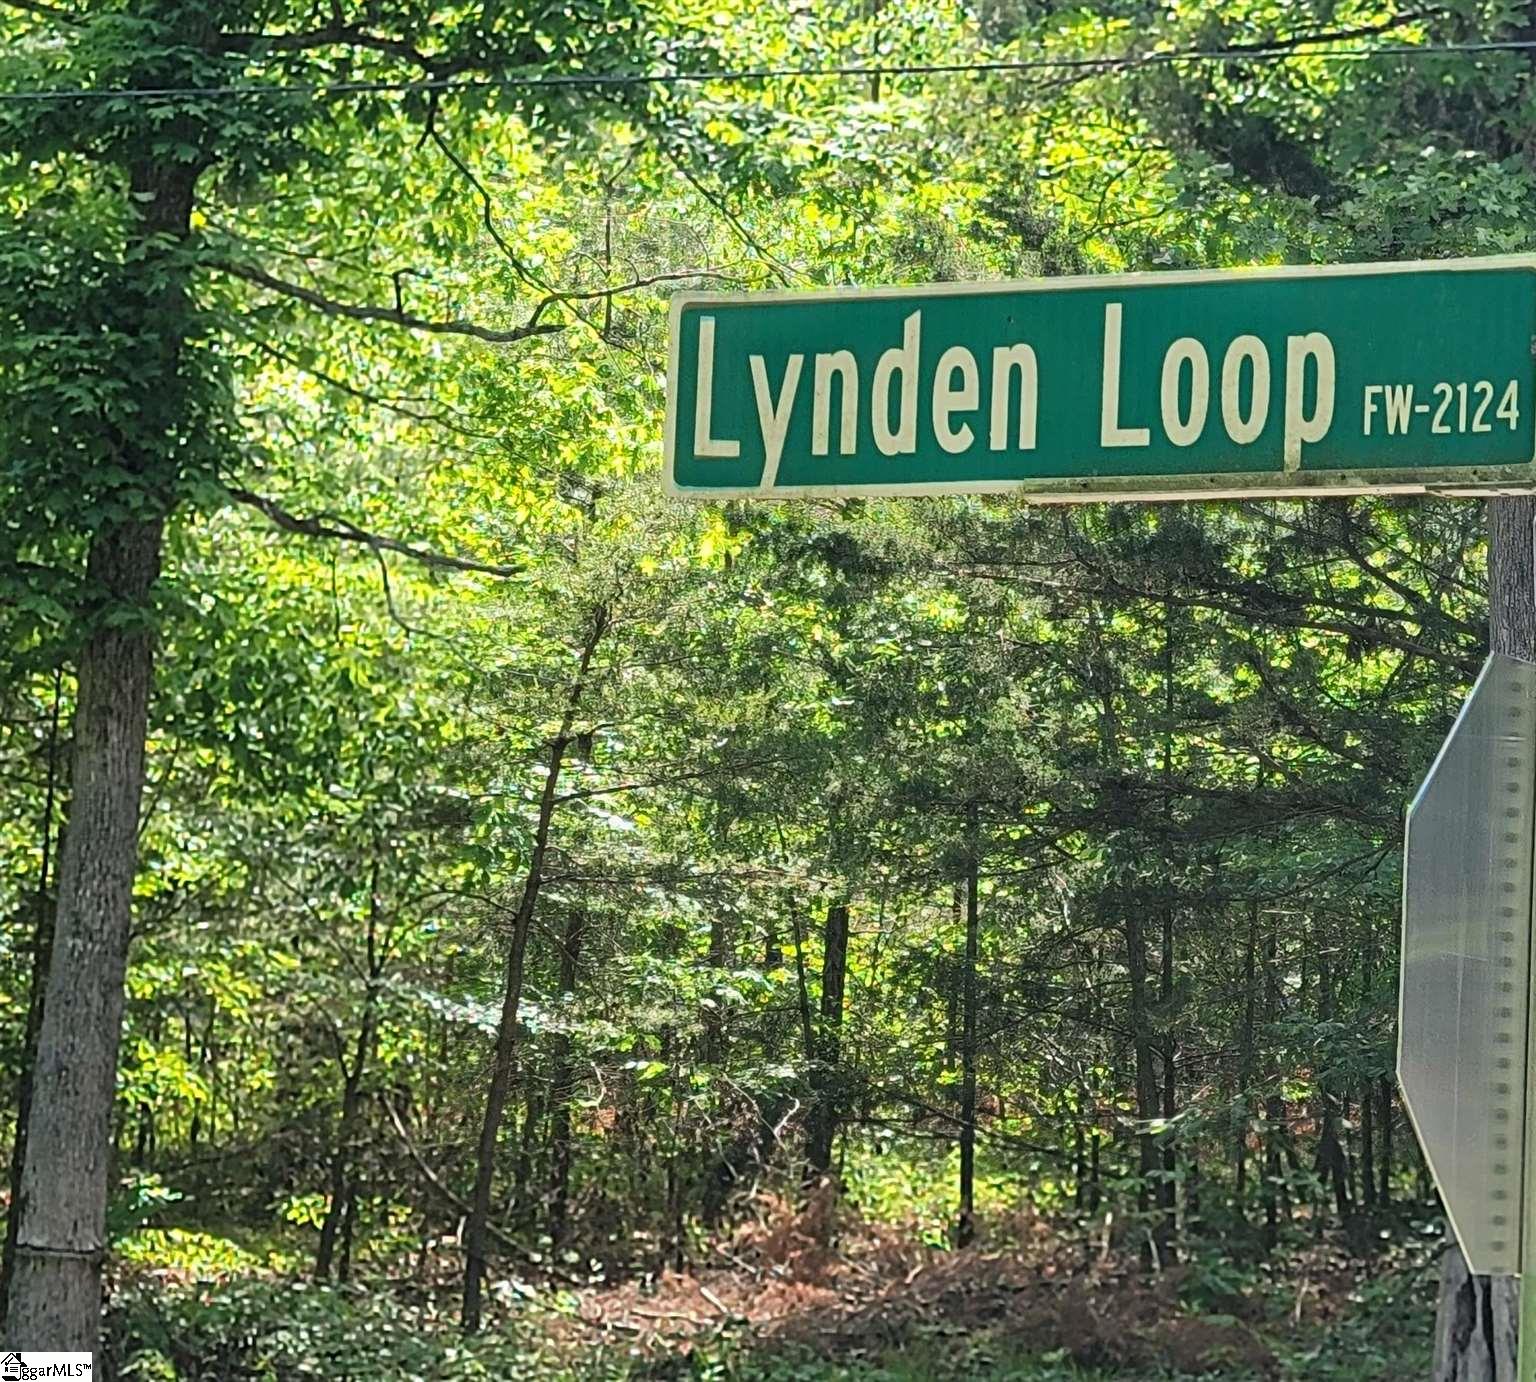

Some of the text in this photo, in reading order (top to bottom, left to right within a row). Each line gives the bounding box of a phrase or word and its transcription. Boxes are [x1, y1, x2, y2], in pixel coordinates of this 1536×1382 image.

[693, 302, 1520, 489] Lynden Loop FW-2124
